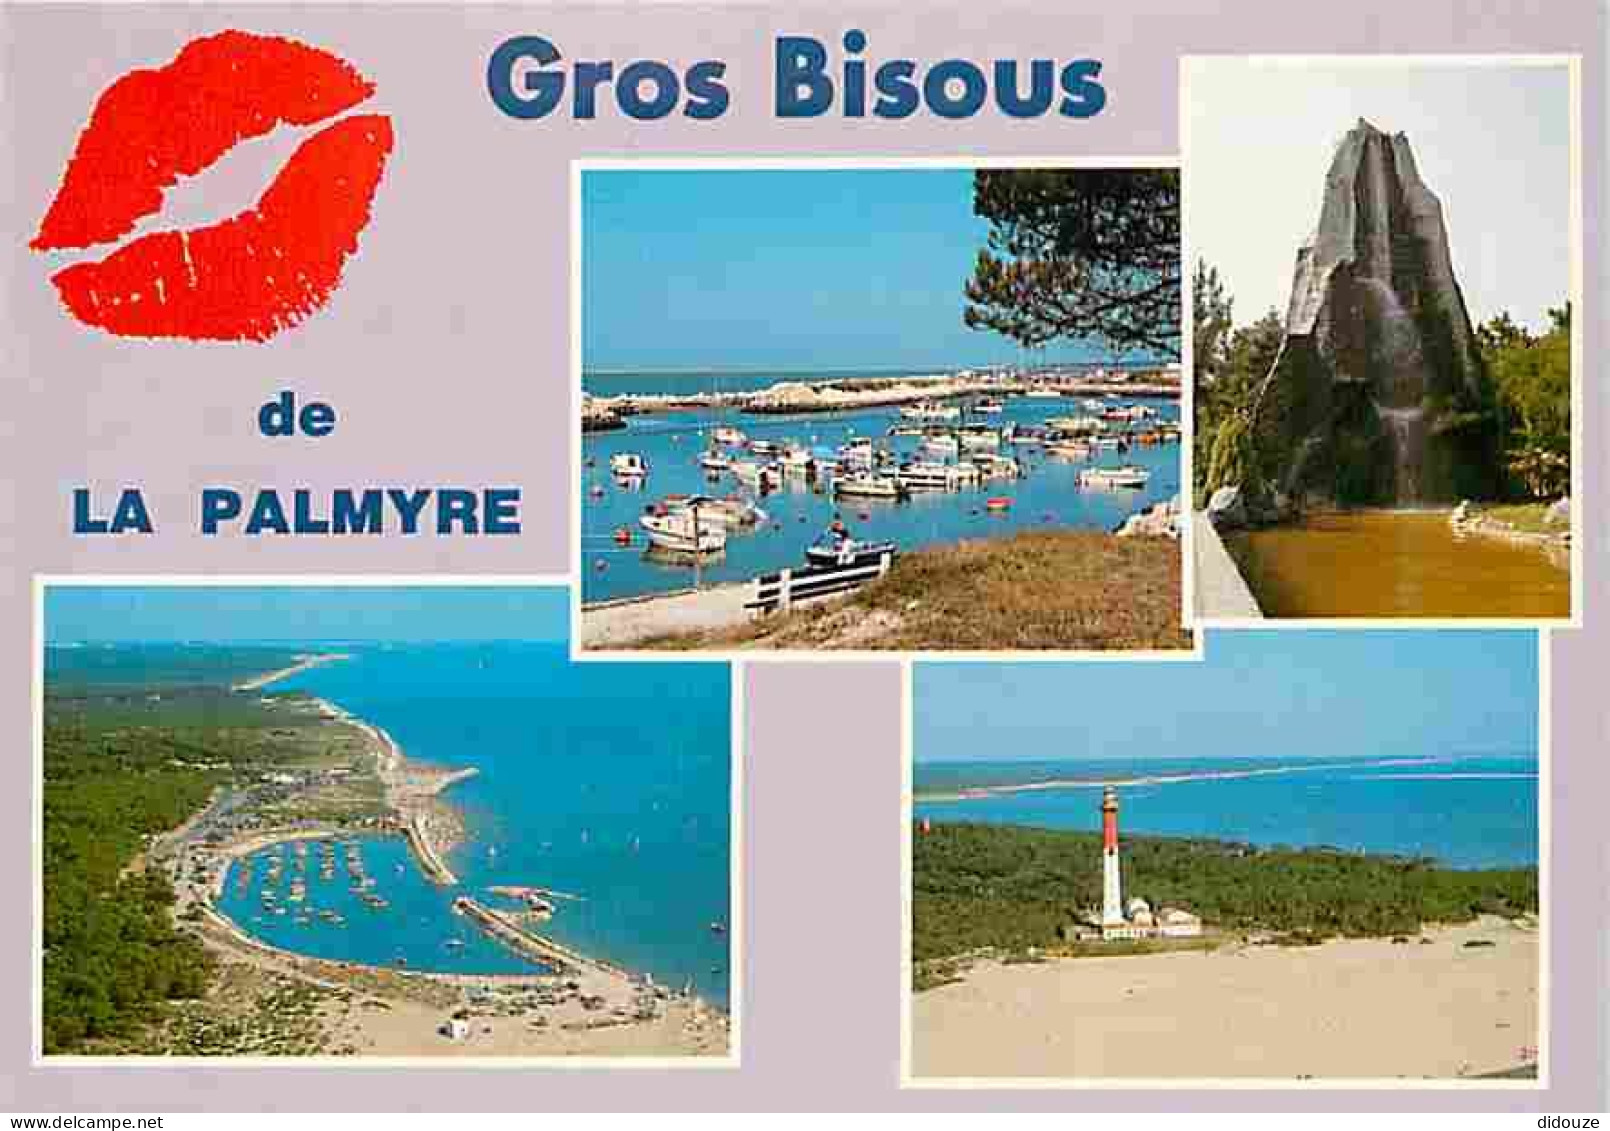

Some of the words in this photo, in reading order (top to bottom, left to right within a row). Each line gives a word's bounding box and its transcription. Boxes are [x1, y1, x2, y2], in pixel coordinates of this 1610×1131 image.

[487, 37, 729, 120] Gros
[774, 28, 1106, 120] Bisous
[258, 390, 335, 437] de
[72, 490, 153, 536] LA
[201, 488, 523, 537] PALMYRE
